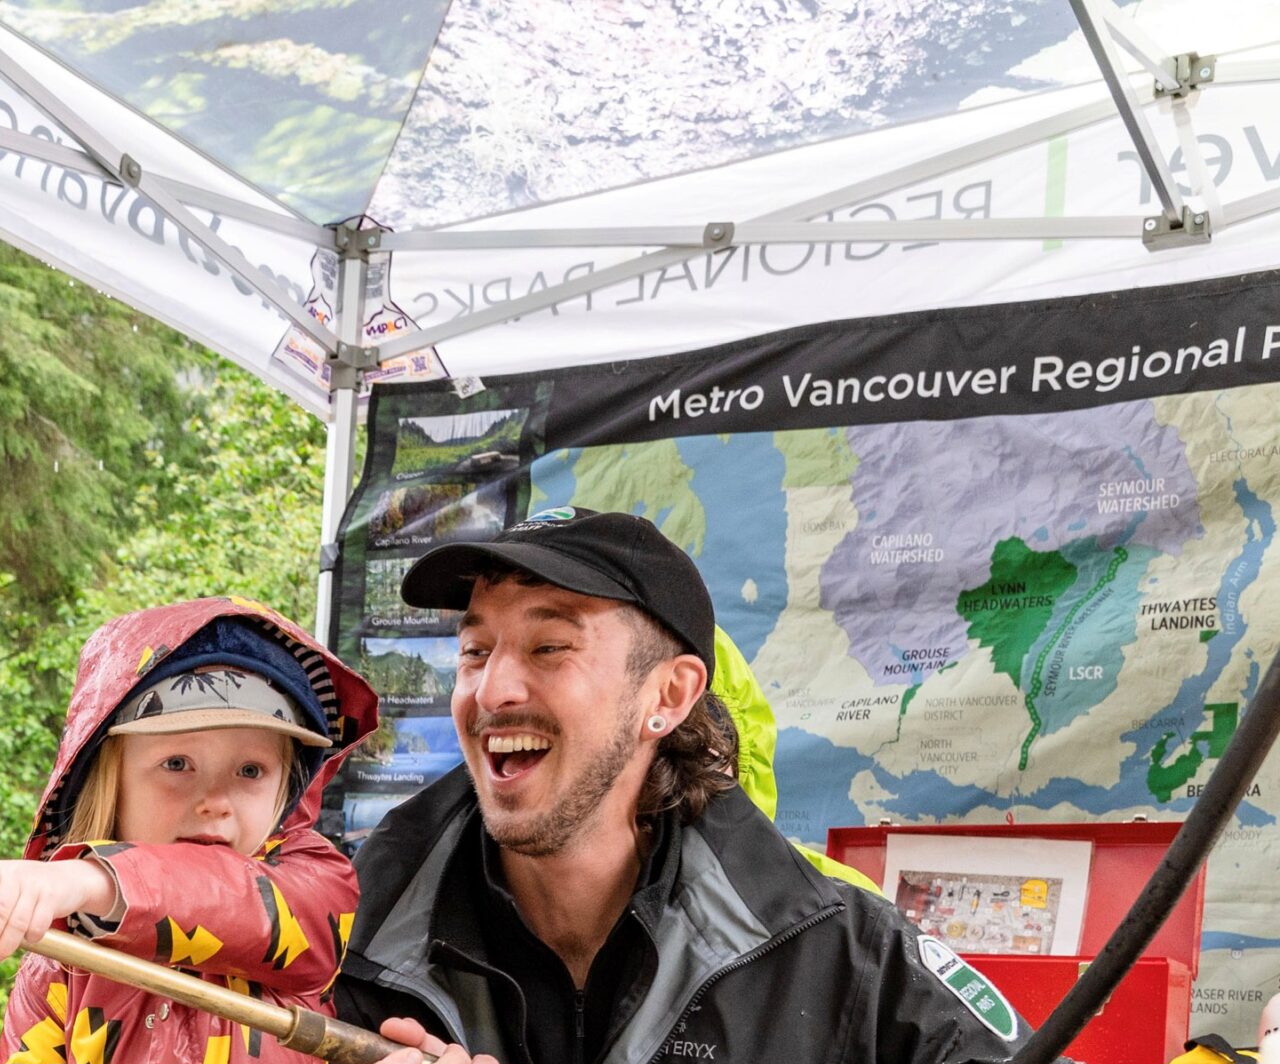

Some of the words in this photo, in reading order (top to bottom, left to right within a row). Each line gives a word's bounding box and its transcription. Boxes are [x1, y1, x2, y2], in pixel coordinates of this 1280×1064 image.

[648, 384, 765, 421] Metro
[782, 365, 1017, 408] Vancouver
[1031, 326, 1246, 394] Regional
[1099, 478, 1165, 497] SEYMOUR
[1097, 494, 1180, 514] WATERSHED
[375, 538, 411, 548] Capilano
[412, 535, 433, 545] River
[872, 533, 933, 549] CAPILANO
[870, 549, 943, 565] WATERSHED
[1230, 561, 1248, 587] Arm
[991, 582, 1027, 596] LYNN
[964, 595, 1053, 613] HEADWATERS
[1141, 597, 1217, 616] THWAYTES
[372, 617, 402, 626] Grouse
[404, 616, 440, 625] Mountain
[1224, 592, 1237, 635] Indian
[1151, 615, 1215, 631] LANDING
[902, 647, 951, 662] GROUSE
[883, 659, 947, 676] MOUNTAIN
[1043, 650, 1065, 697] SEYMOUR
[1069, 666, 1104, 681] LSCR
[387, 695, 434, 704] Headwaters
[841, 694, 899, 710] CAPILANO
[925, 697, 956, 708] NORTH
[959, 695, 1018, 707] VANCOUVER
[836, 709, 871, 721] RIVER
[924, 710, 964, 721] DISTRICT
[920, 739, 952, 749] NORTH
[920, 752, 977, 763] VANCOUVER
[939, 765, 959, 775] CITY
[393, 772, 424, 784] Landing
[1228, 989, 1263, 1002] RIVER
[1190, 1003, 1228, 1015] LANDS
